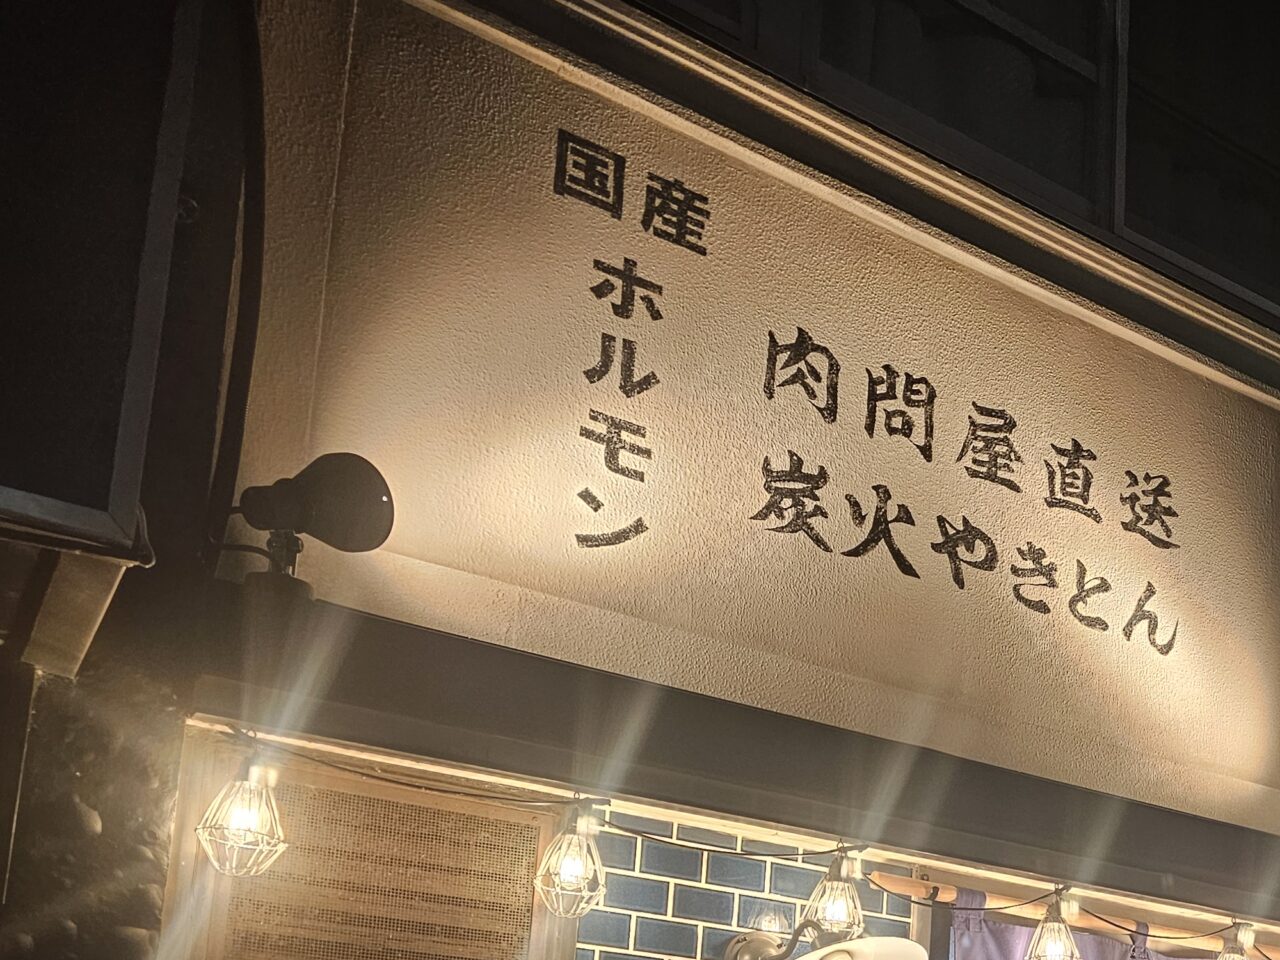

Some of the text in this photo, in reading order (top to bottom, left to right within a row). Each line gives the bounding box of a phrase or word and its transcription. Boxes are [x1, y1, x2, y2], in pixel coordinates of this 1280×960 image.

[552, 128, 711, 257] 国産
[572, 256, 665, 550] ホルモン
[761, 325, 1182, 551] 肉問屋直送
[748, 448, 1180, 657] 炭火やきとん
